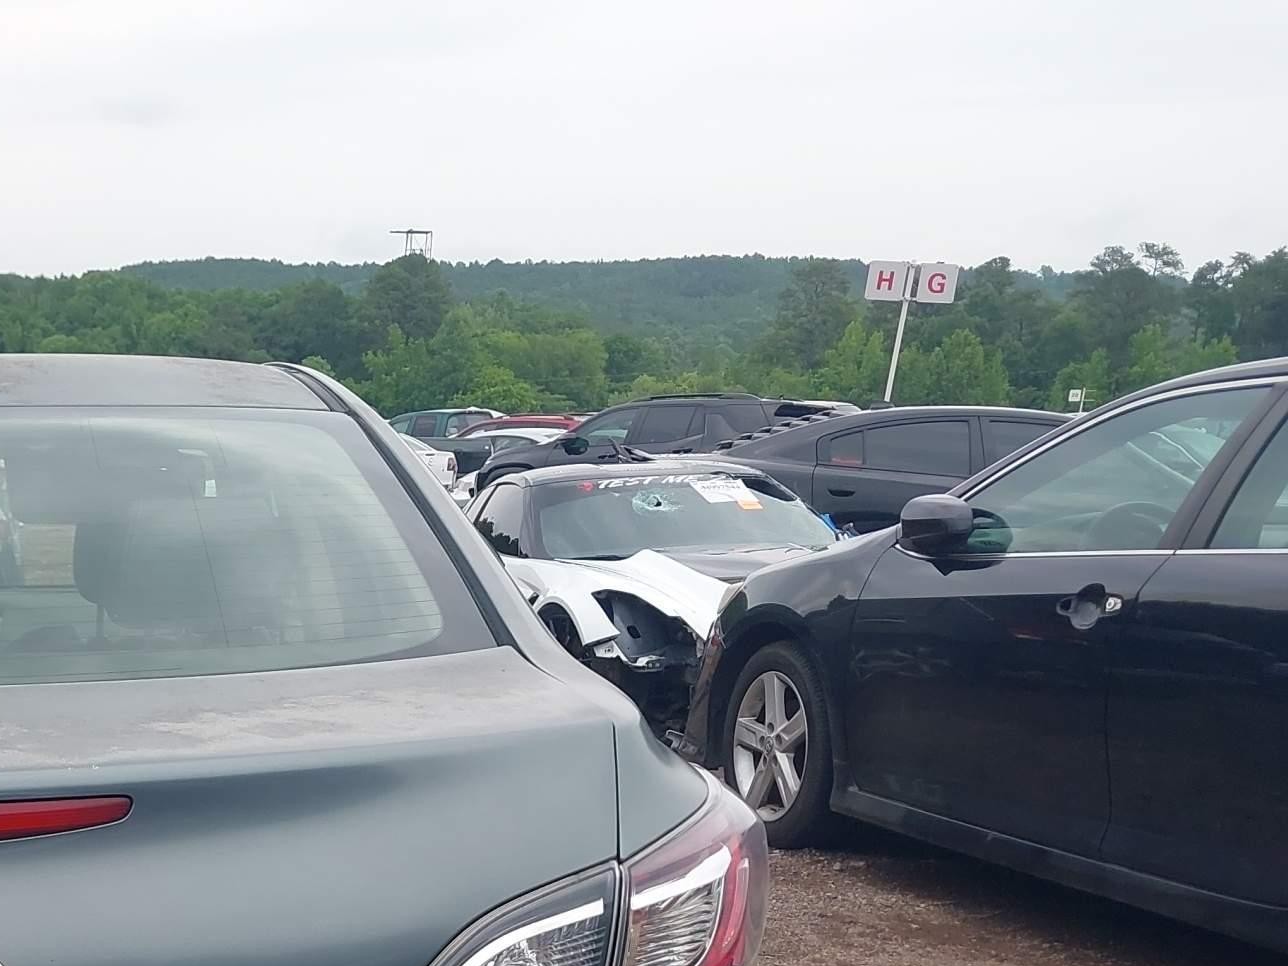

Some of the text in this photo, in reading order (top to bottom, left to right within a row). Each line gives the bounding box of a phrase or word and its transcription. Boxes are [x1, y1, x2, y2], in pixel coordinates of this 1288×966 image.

[876, 270, 895, 291] H
[927, 273, 947, 293] G
[598, 476, 659, 489] TEST
